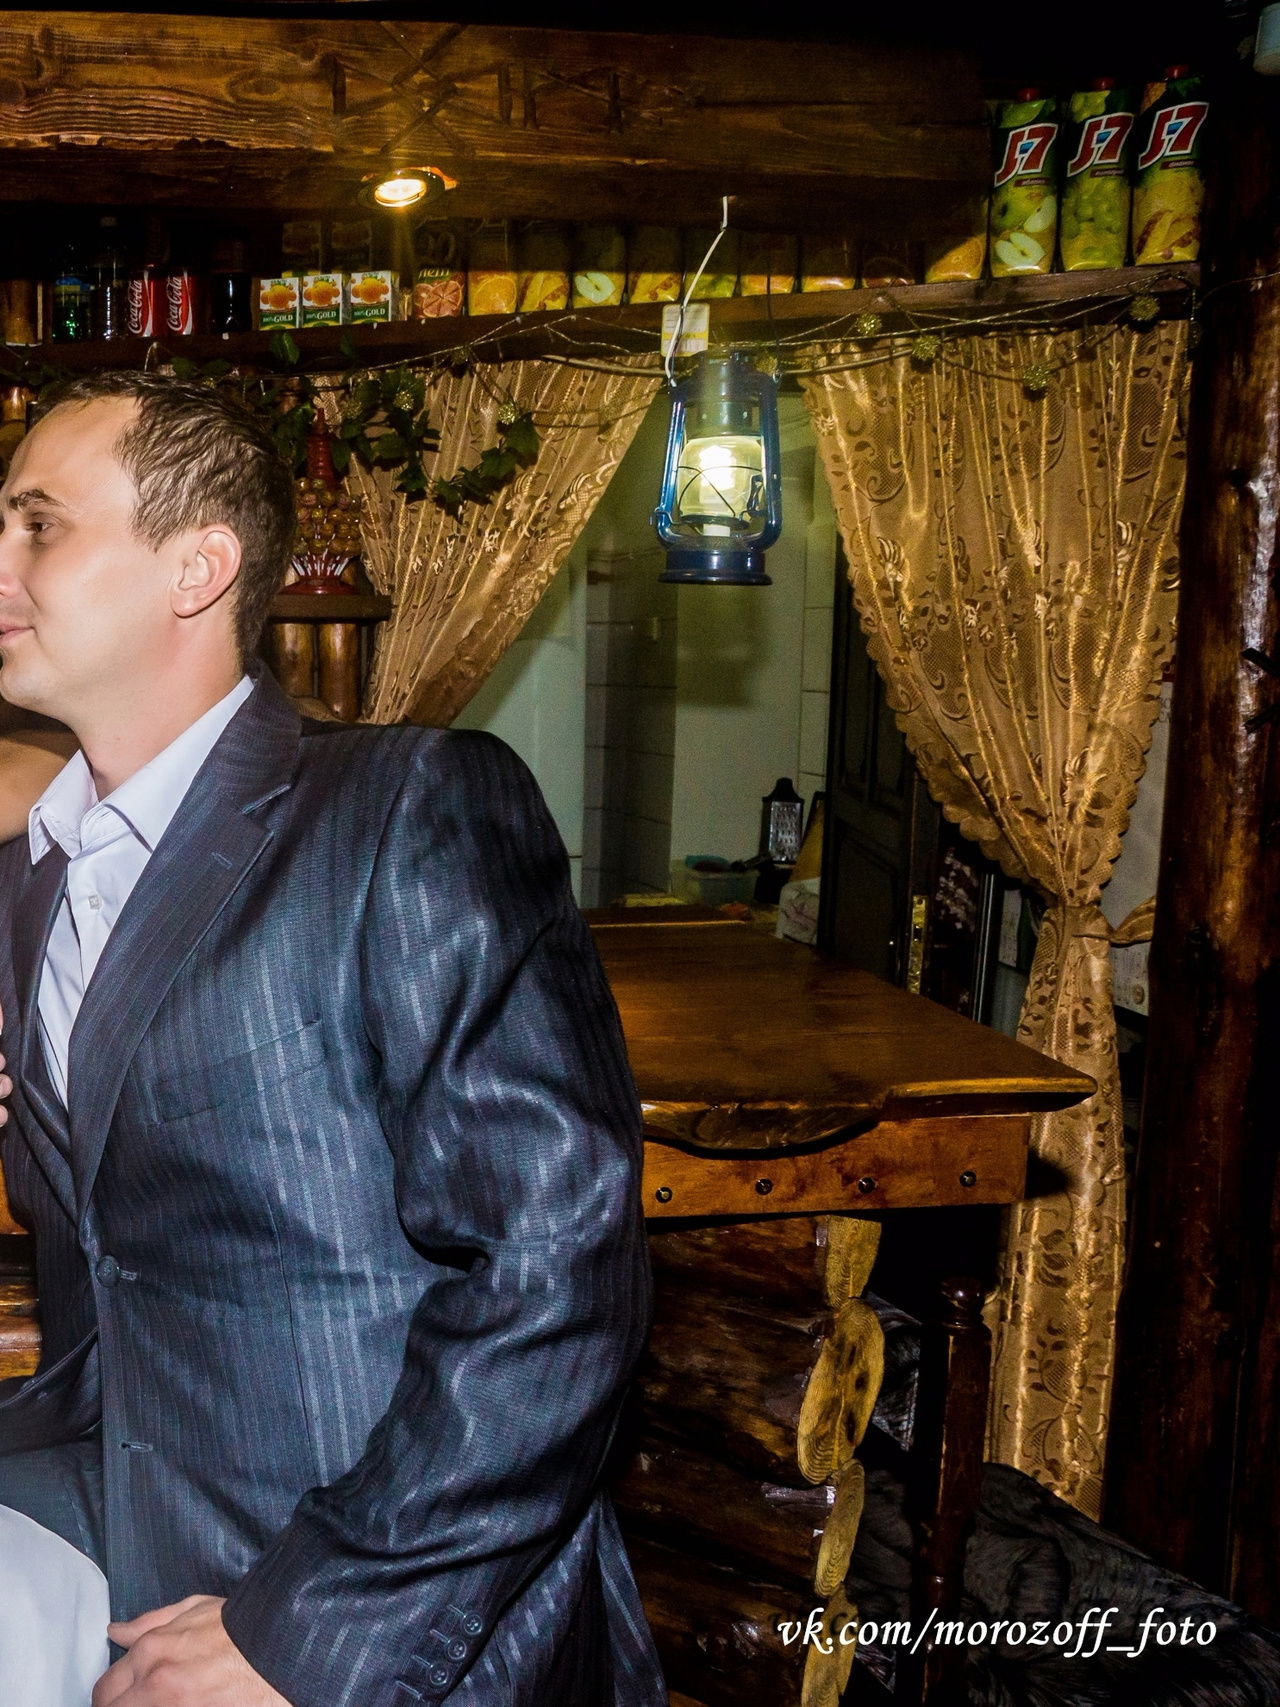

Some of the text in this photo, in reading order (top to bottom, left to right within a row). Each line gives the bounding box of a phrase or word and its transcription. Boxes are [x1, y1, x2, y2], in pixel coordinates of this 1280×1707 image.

[1067, 112, 1134, 177] J7
[1138, 101, 1210, 170] J7
[994, 122, 1058, 188] J7
[273, 314, 294, 323] GOLD
[316, 311, 337, 320] GOLD
[365, 308, 386, 317] GOLD
